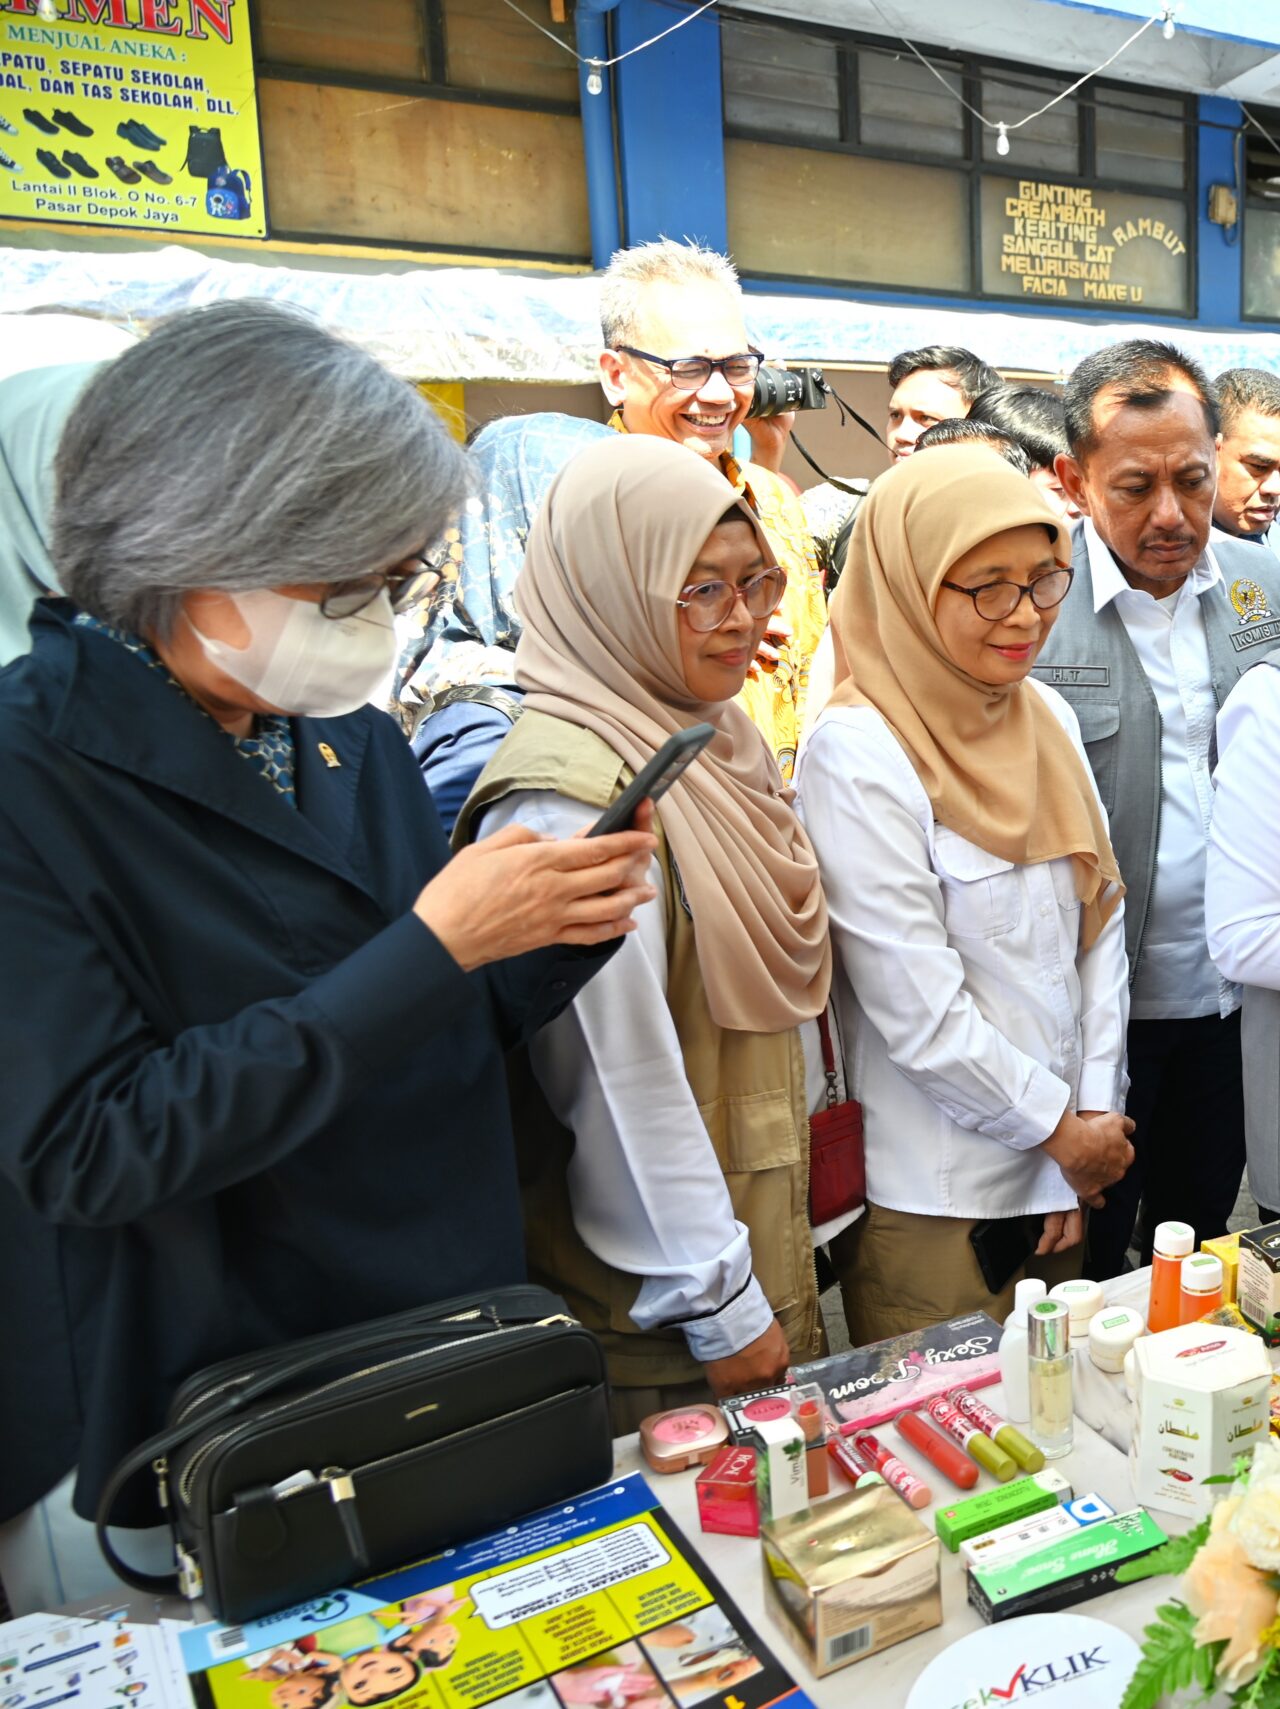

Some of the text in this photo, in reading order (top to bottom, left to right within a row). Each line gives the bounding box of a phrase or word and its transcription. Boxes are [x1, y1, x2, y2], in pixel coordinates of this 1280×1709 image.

[8, 25, 104, 52] MENJUAL
[110, 39, 176, 61] ANEKA
[0, 53, 210, 93] PATU, SEPATU SEKOLAH,
[40, 78, 75, 95] DAN
[82, 82, 112, 100] TAS
[121, 90, 199, 112] SEKOLAH,
[207, 98, 240, 115] DLL.
[12, 180, 62, 195] Lantai
[83, 186, 122, 201] Blok.
[145, 193, 169, 205] No.
[176, 196, 196, 207] 6-7
[1019, 181, 1092, 207] GUNTING
[36, 198, 179, 223] Pasar Depok Jaya
[1006, 198, 1105, 227] CREAMBATH
[1015, 219, 1097, 243] KERITING
[1112, 218, 1186, 256] RAMBUT
[1003, 234, 1115, 263] SANGGUL CAT
[1002, 255, 1110, 281] MELURUSKAN
[1023, 276, 1068, 296] FACIA
[1084, 281, 1127, 301] MAKE
[1235, 624, 1273, 646] KOMISI
[510, 1562, 648, 1620] BIASAKAN CUCI TANGAN
[1019, 1645, 1111, 1693] KLIK
